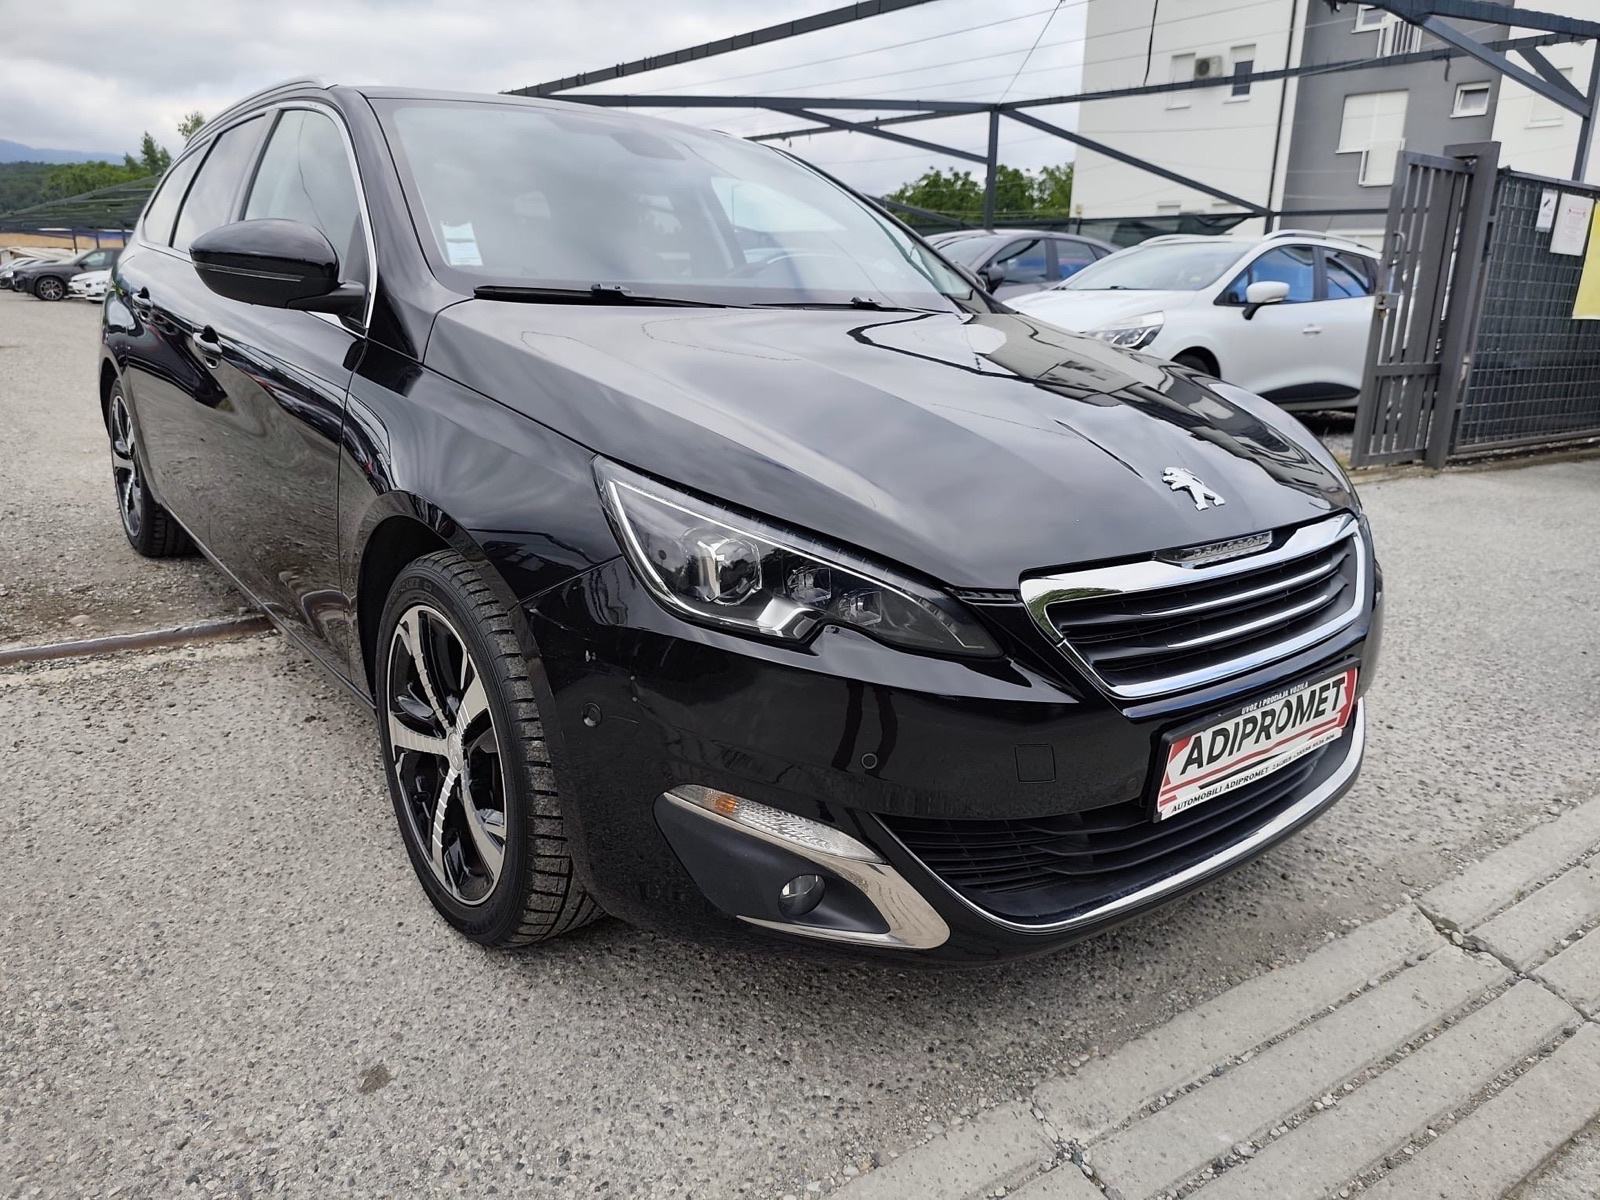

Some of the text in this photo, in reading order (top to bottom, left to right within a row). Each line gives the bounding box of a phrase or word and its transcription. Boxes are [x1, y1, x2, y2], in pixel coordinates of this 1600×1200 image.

[1180, 677, 1346, 776] ADIPROMET
[1241, 701, 1258, 714] UVOZ
[1171, 787, 1223, 813] AUTOMOBILI
[1224, 767, 1269, 790] ADIPROMET
